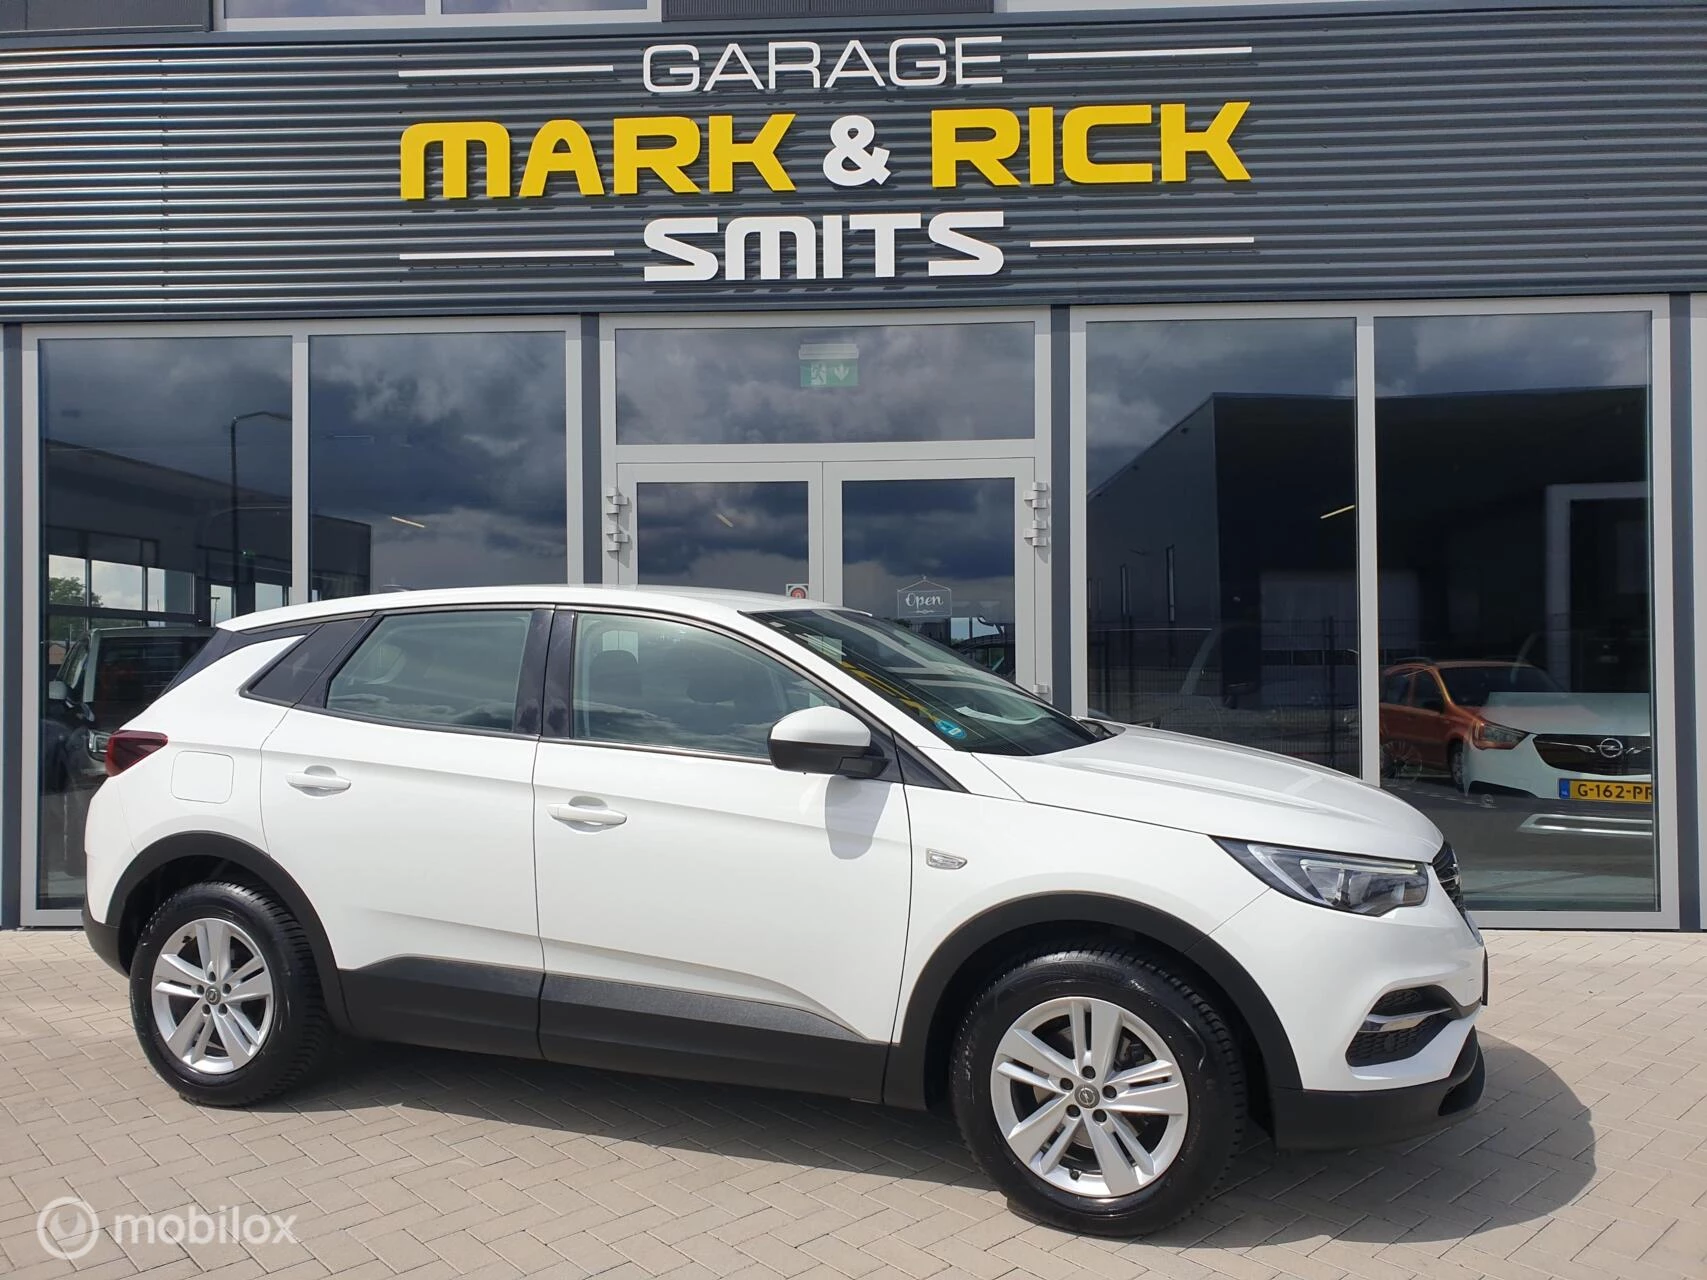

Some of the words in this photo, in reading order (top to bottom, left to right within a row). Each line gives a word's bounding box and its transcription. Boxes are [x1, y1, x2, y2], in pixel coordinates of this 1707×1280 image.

[643, 36, 1003, 93] GARAGE
[399, 114, 797, 201] MARK
[823, 114, 891, 186] &
[930, 101, 1252, 188] RICK
[643, 211, 1004, 282] SMITS
[905, 592, 944, 609] Open
